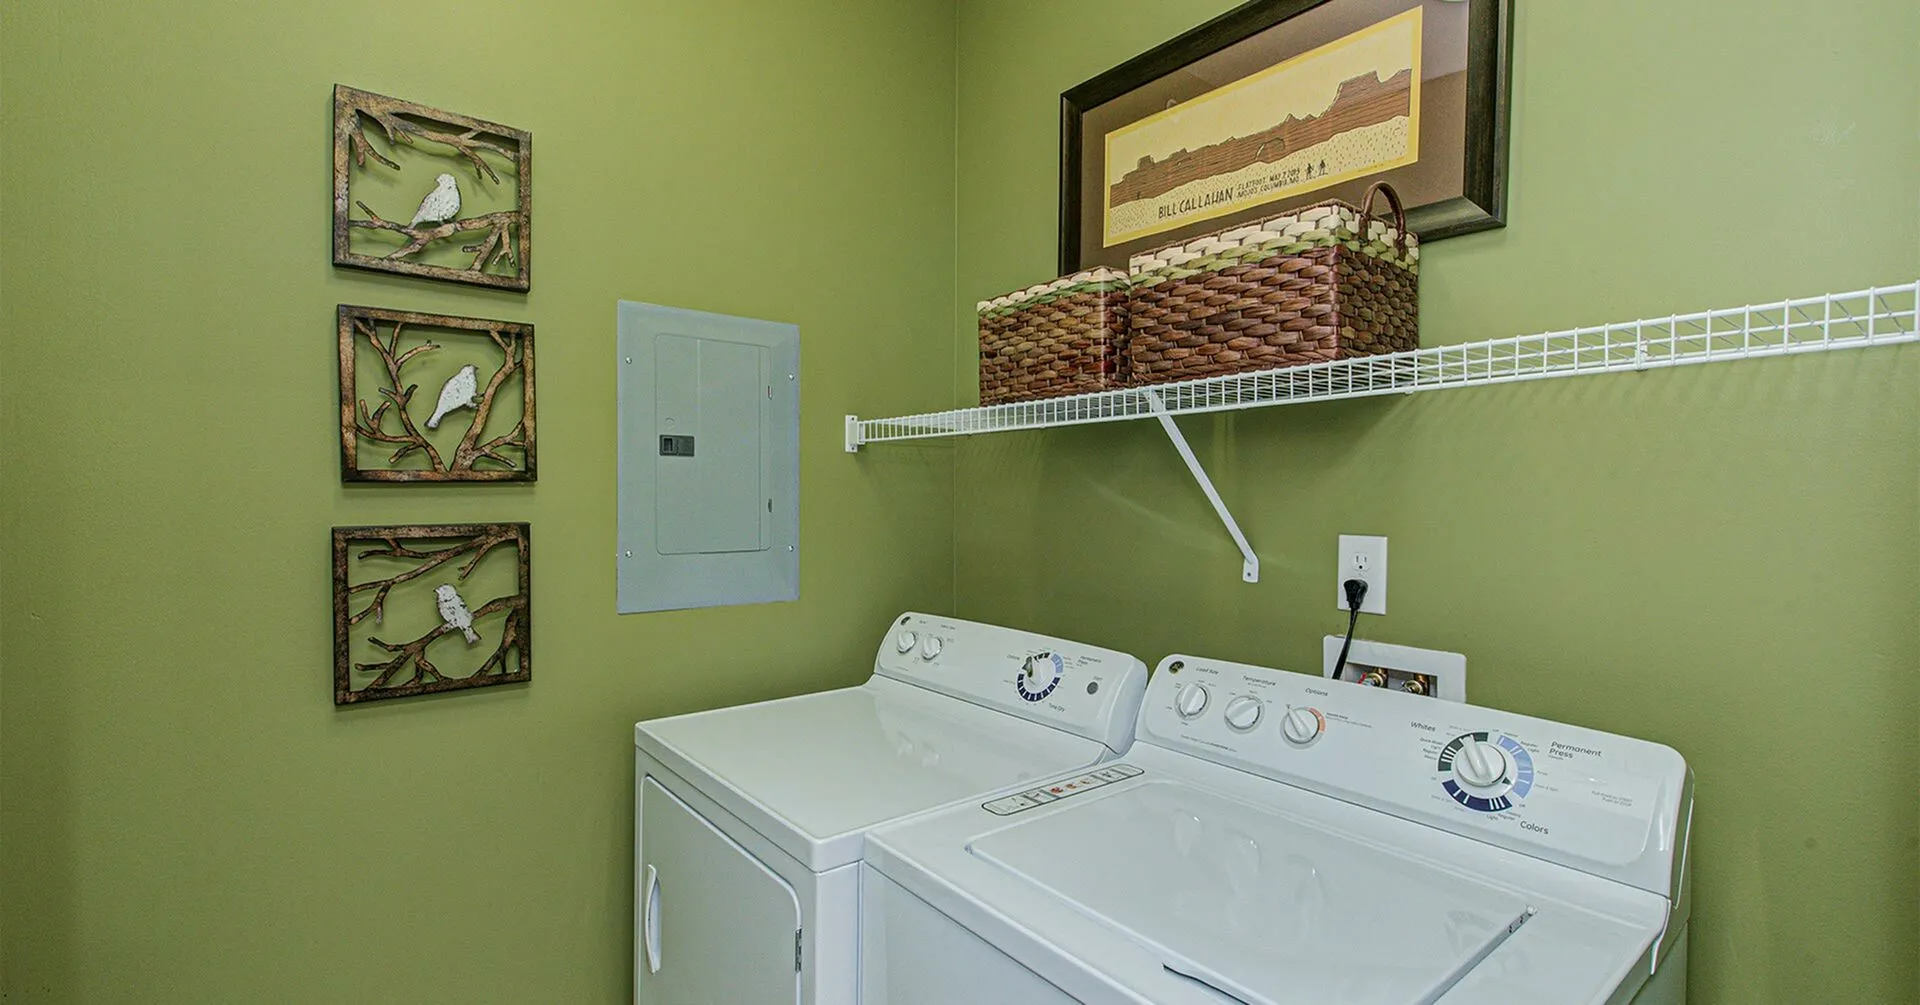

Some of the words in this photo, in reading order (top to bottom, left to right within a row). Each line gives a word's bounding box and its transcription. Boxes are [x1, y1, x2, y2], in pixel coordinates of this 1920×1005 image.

[1158, 203, 1177, 218] BILL
[1179, 187, 1234, 213] CALLAHAN
[1243, 675, 1276, 687] Temperature
[1305, 687, 1328, 697] Options
[1410, 721, 1436, 731] Whites
[1549, 748, 1573, 759] Press
[1551, 740, 1602, 757] Permanent
[1520, 820, 1549, 835] Colors
